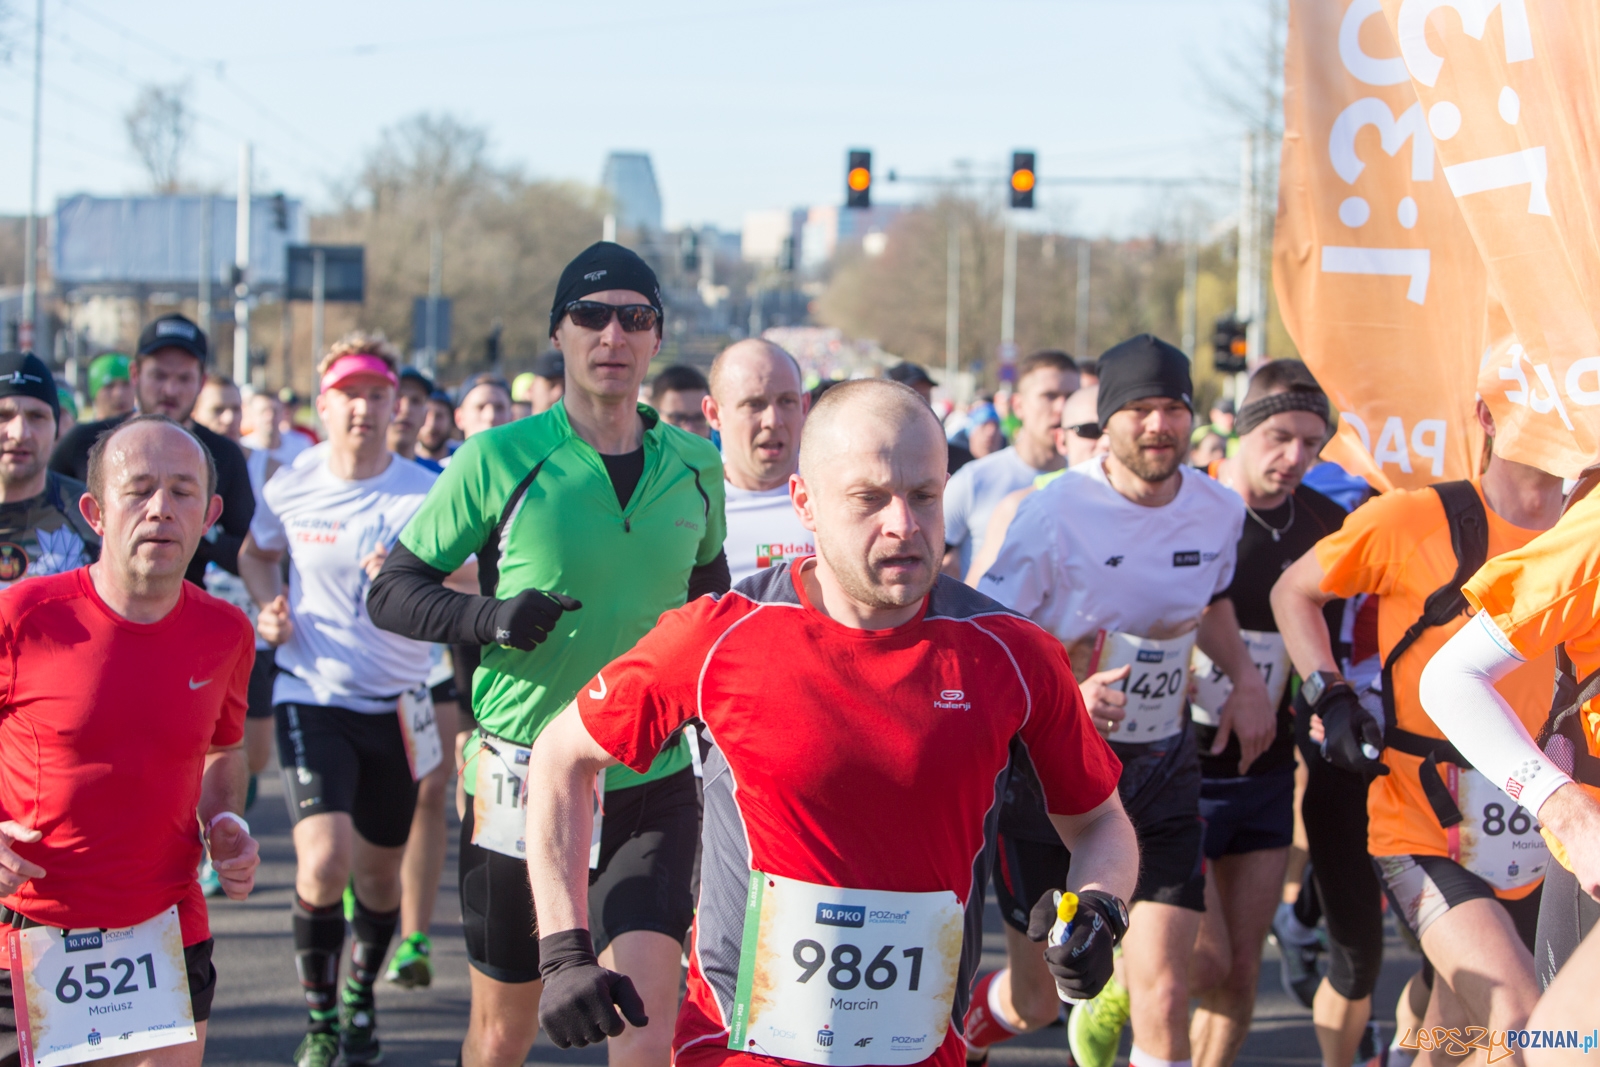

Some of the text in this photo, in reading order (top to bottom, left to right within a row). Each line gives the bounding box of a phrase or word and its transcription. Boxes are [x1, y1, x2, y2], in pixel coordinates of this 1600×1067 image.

[933, 700, 971, 712] Kalenji
[820, 908, 835, 920] 10.
[836, 910, 862, 922] PKO
[81, 936, 100, 946] PKO
[792, 939, 924, 991] 9861
[55, 953, 157, 1004] 6521
[88, 999, 133, 1016] Mariusz
[829, 997, 878, 1011] Marcin
